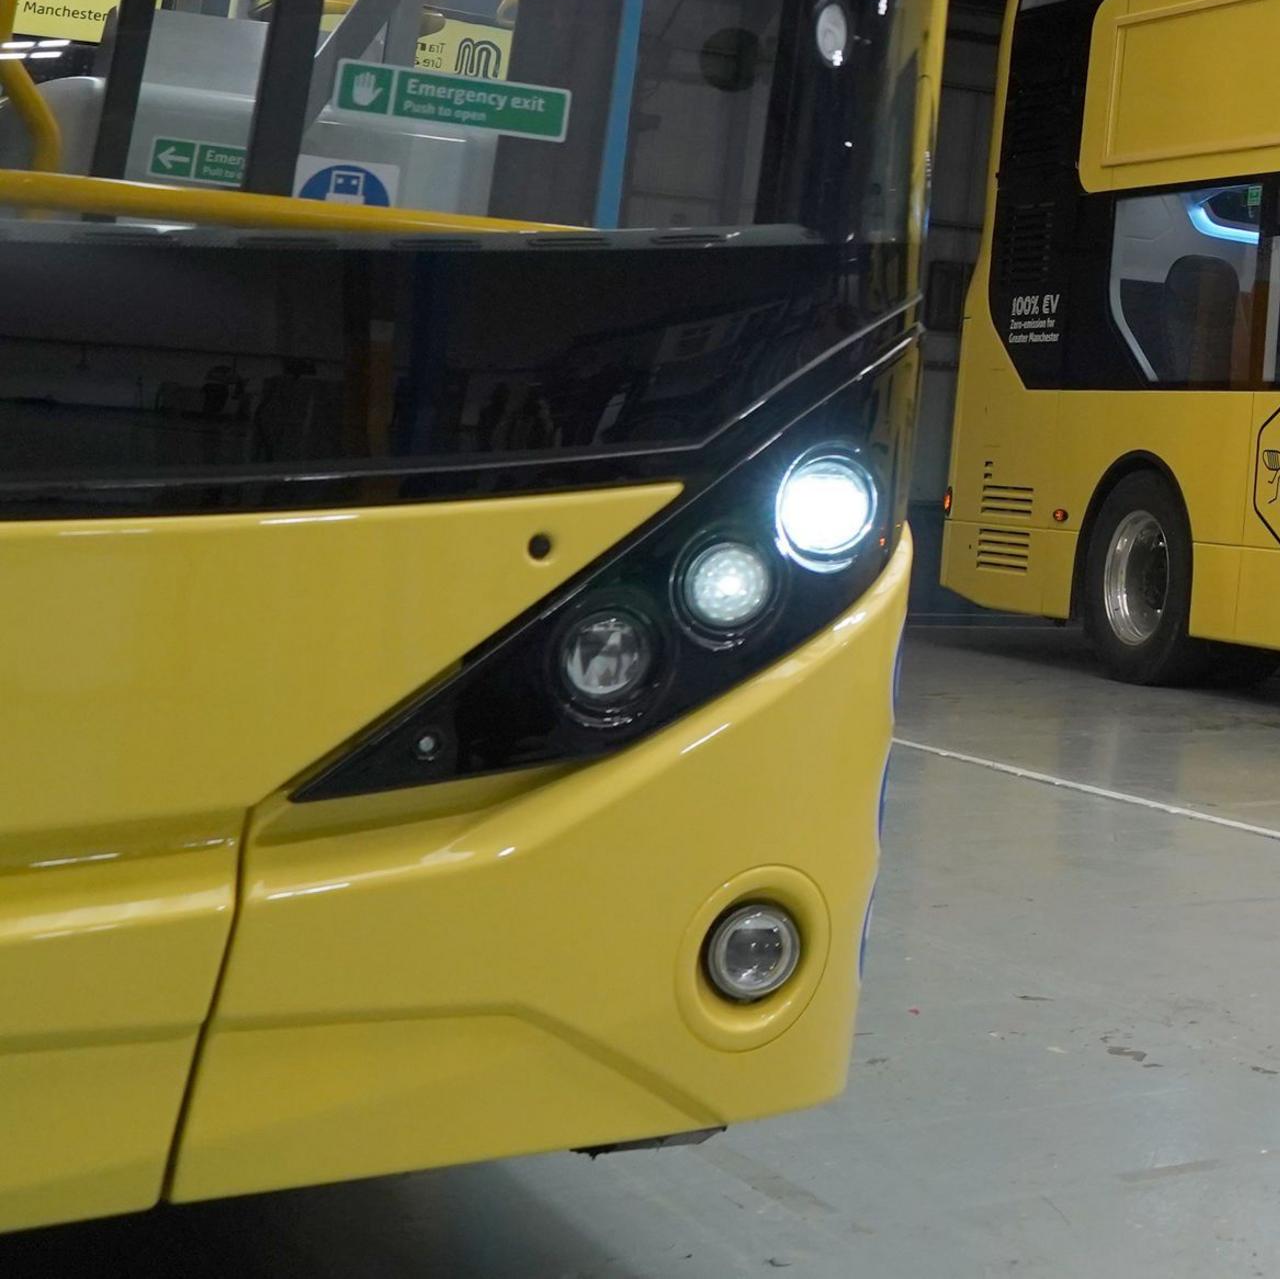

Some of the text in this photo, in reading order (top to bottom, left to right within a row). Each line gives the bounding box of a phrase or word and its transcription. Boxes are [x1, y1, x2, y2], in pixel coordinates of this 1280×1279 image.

[23, 1, 110, 22] Manchester
[406, 78, 545, 112] Emergency exit
[402, 99, 487, 122] Push to open
[1011, 293, 1060, 316] 100% EV
